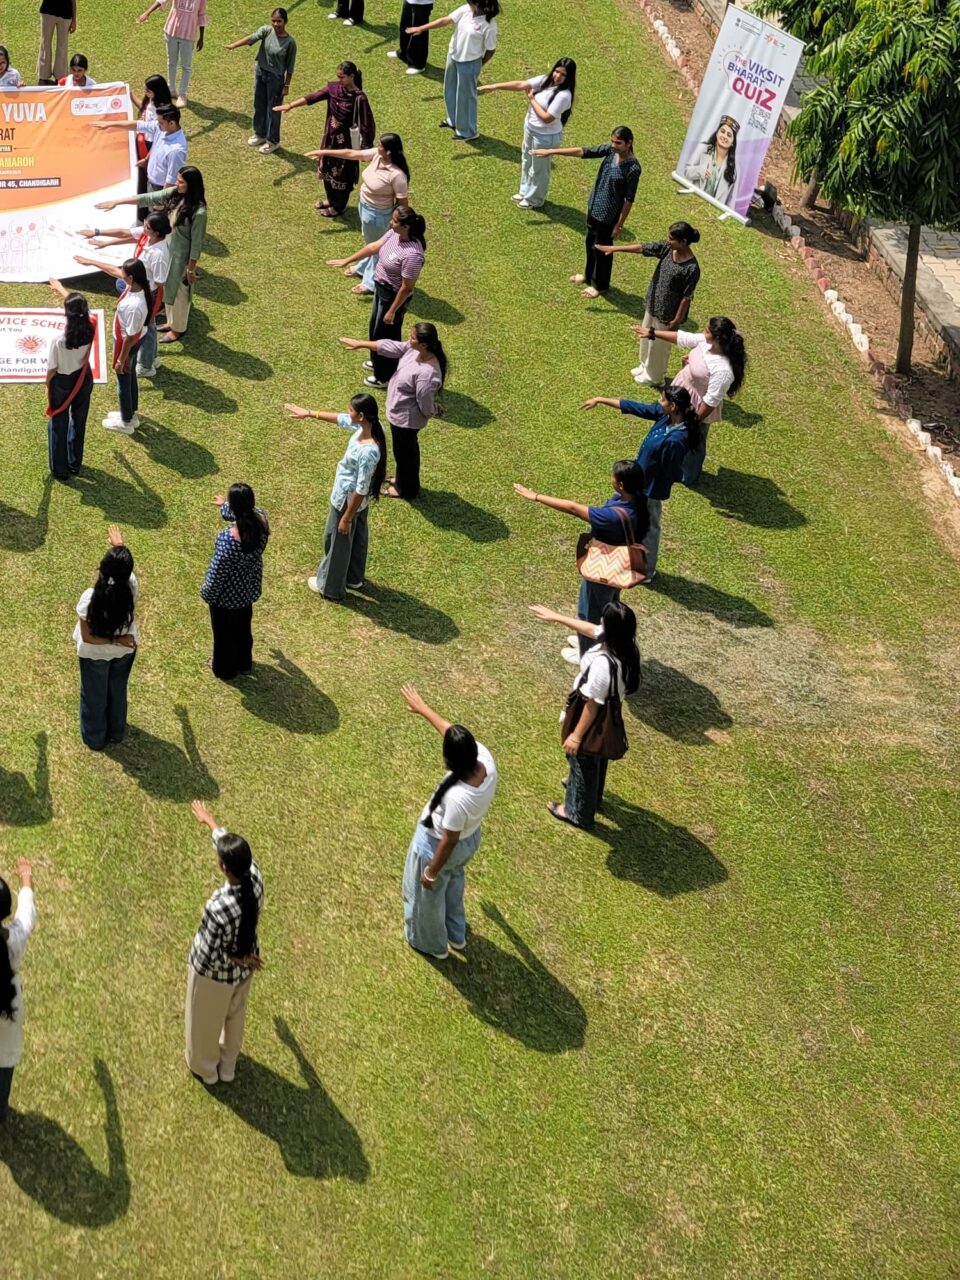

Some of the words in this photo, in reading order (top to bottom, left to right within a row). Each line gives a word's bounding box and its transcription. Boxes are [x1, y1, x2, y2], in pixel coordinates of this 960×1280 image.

[727, 61, 766, 88] BHARAT
[748, 58, 785, 88] VIKSIT
[732, 76, 777, 112] QUIZ
[1, 102, 48, 123] YUVA
[7, 180, 18, 188] 45,
[19, 178, 60, 188] CHANDIGARH
[15, 357, 37, 365] FOR
